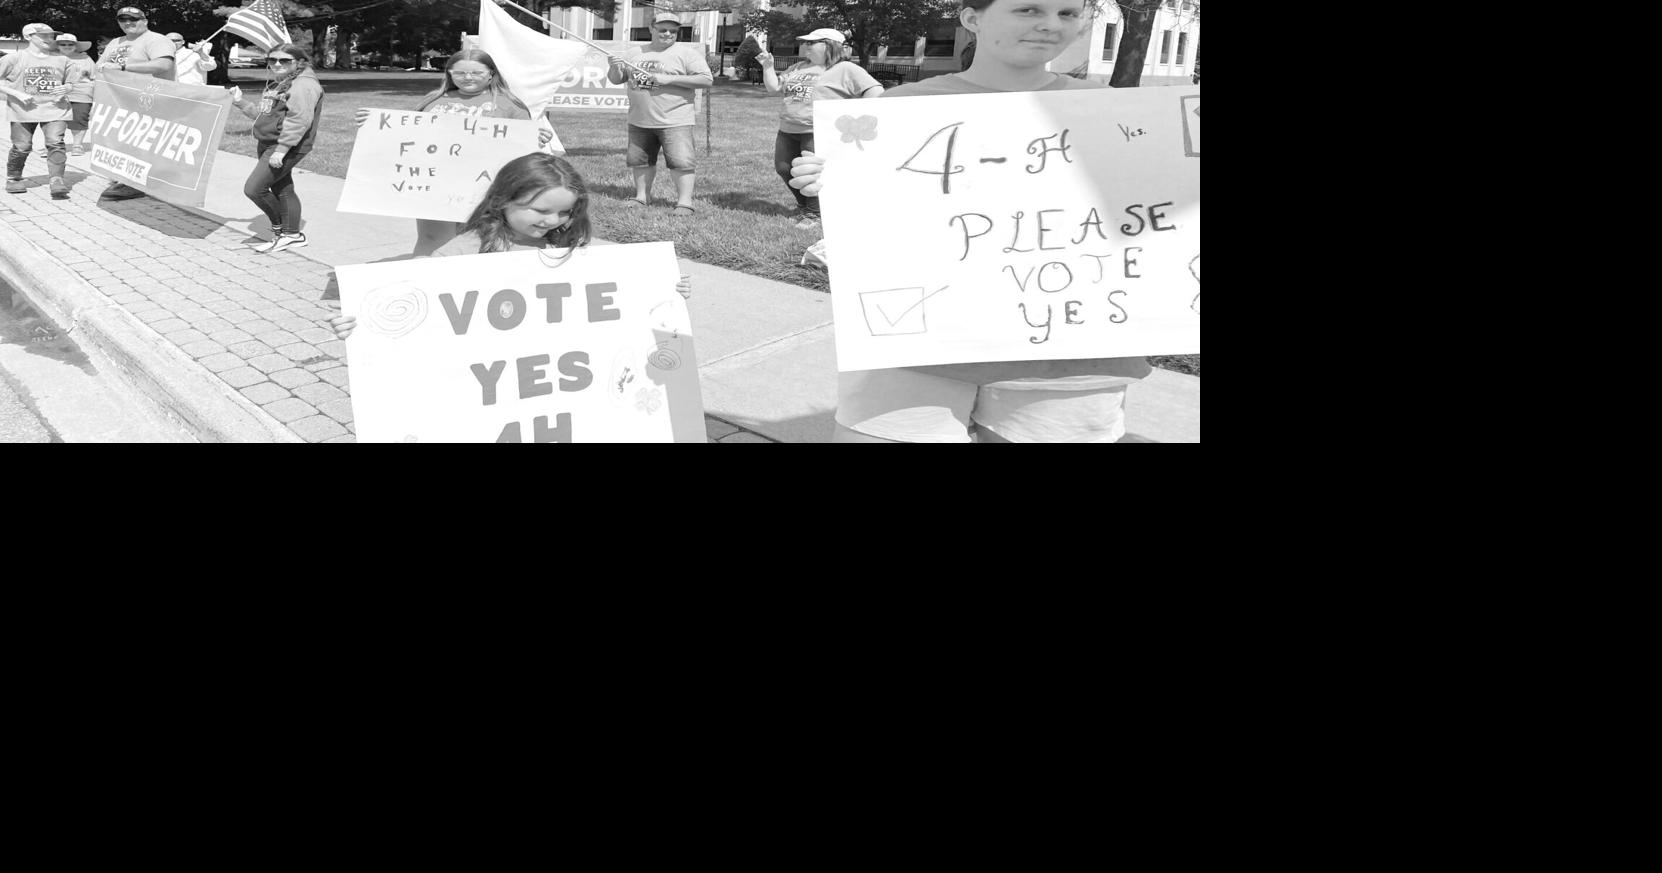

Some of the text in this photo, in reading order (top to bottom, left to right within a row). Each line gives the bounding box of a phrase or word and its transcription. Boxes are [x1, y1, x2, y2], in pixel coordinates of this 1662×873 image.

[103, 108, 202, 165] FOREVER
[380, 112, 508, 138] KEEP 4-H
[1118, 123, 1147, 142] Yes.
[93, 149, 146, 178] PLEASE VOTE
[400, 141, 462, 156] FOR
[395, 163, 437, 177] THE
[949, 202, 1177, 261] PLEASE
[1002, 246, 1143, 293] VOTE
[438, 282, 621, 335] VOTE
[469, 351, 594, 406] YES
